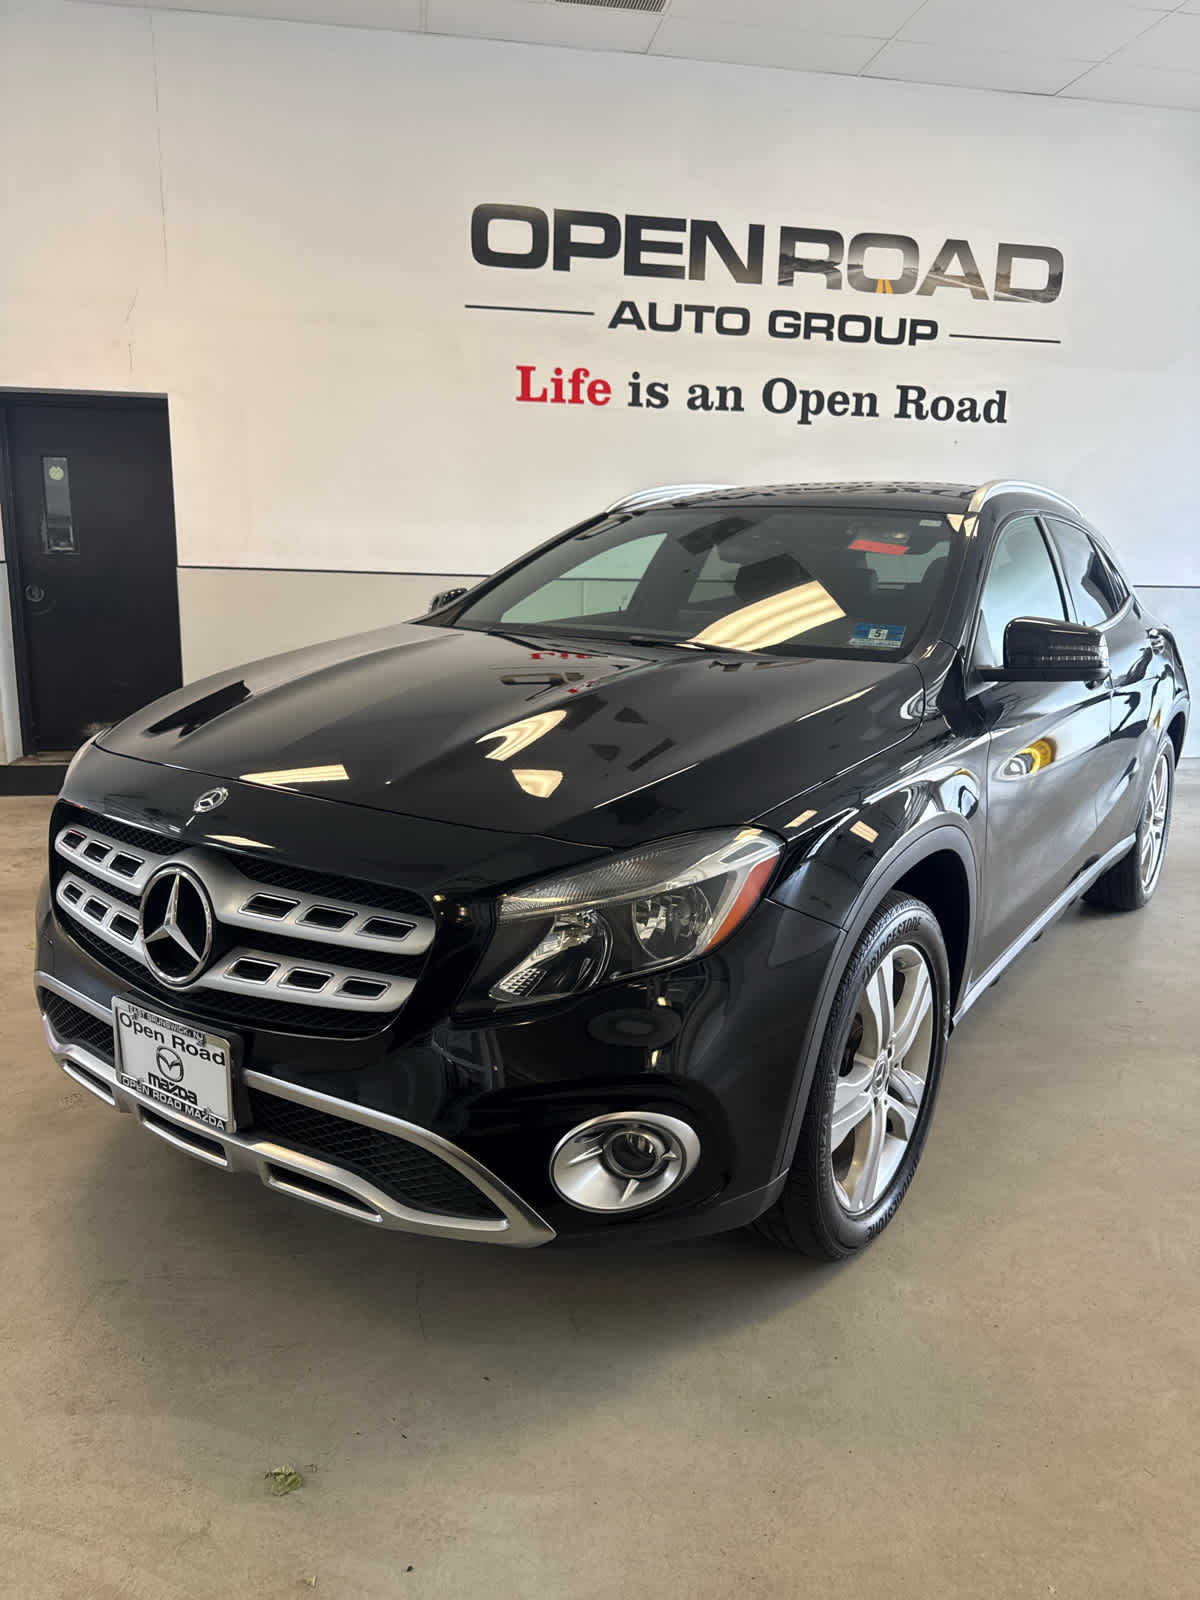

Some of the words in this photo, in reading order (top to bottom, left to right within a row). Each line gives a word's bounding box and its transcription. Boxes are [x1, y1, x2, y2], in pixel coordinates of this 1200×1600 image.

[470, 203, 766, 285] OPEN
[777, 225, 1064, 304] ROAD
[607, 300, 751, 337] AUTO
[768, 309, 939, 347] GROUP
[515, 365, 612, 407] Life
[627, 371, 670, 409] is
[686, 384, 745, 412] an
[762, 377, 880, 426] Open
[893, 384, 1009, 424] Road
[119, 1012, 166, 1045] Open
[171, 1033, 227, 1067] Road
[121, 1077, 150, 1096] OPEN
[152, 1090, 182, 1110] ROAD
[184, 1104, 226, 1131] MAZDA
